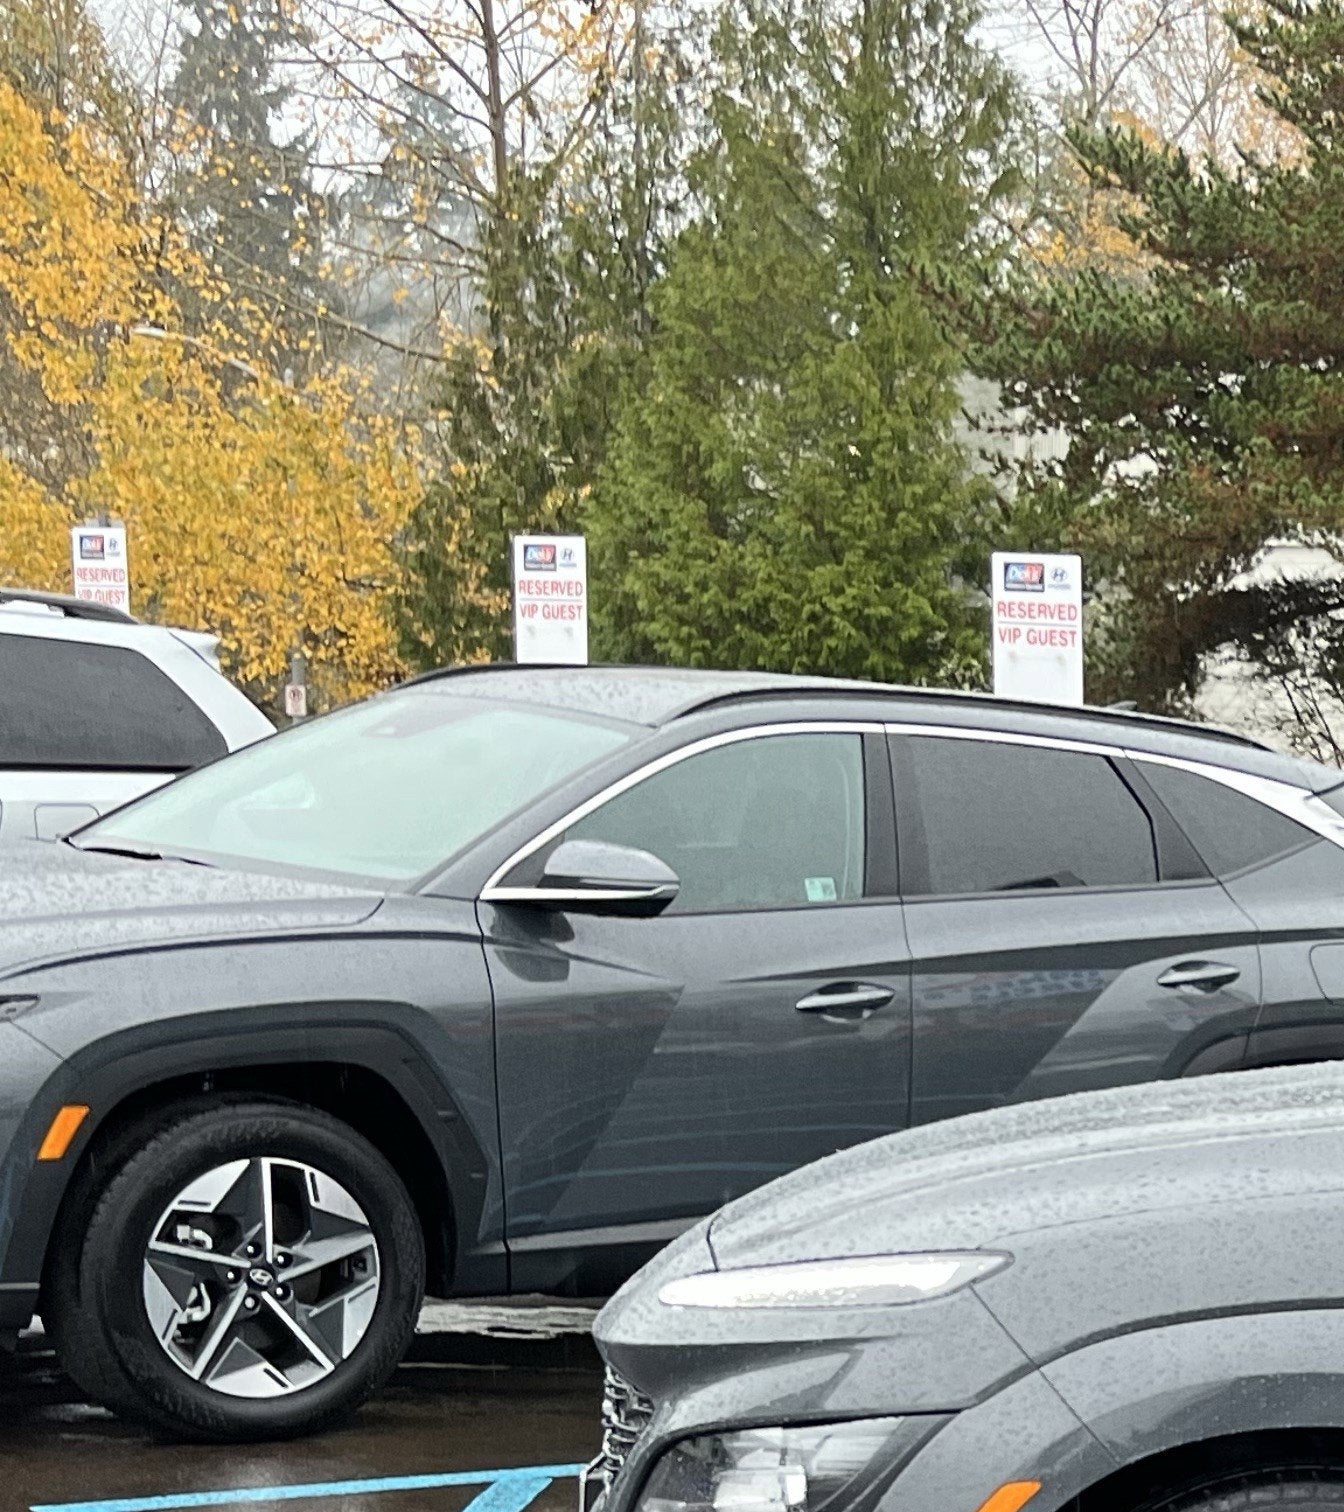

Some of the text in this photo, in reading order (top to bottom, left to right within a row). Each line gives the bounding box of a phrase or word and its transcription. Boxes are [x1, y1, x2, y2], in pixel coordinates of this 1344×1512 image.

[519, 579, 583, 597] RESERVED
[520, 603, 583, 620] VIP GUEST
[997, 601, 1078, 621] RESERVED
[998, 627, 1077, 648] VIP GUEST
